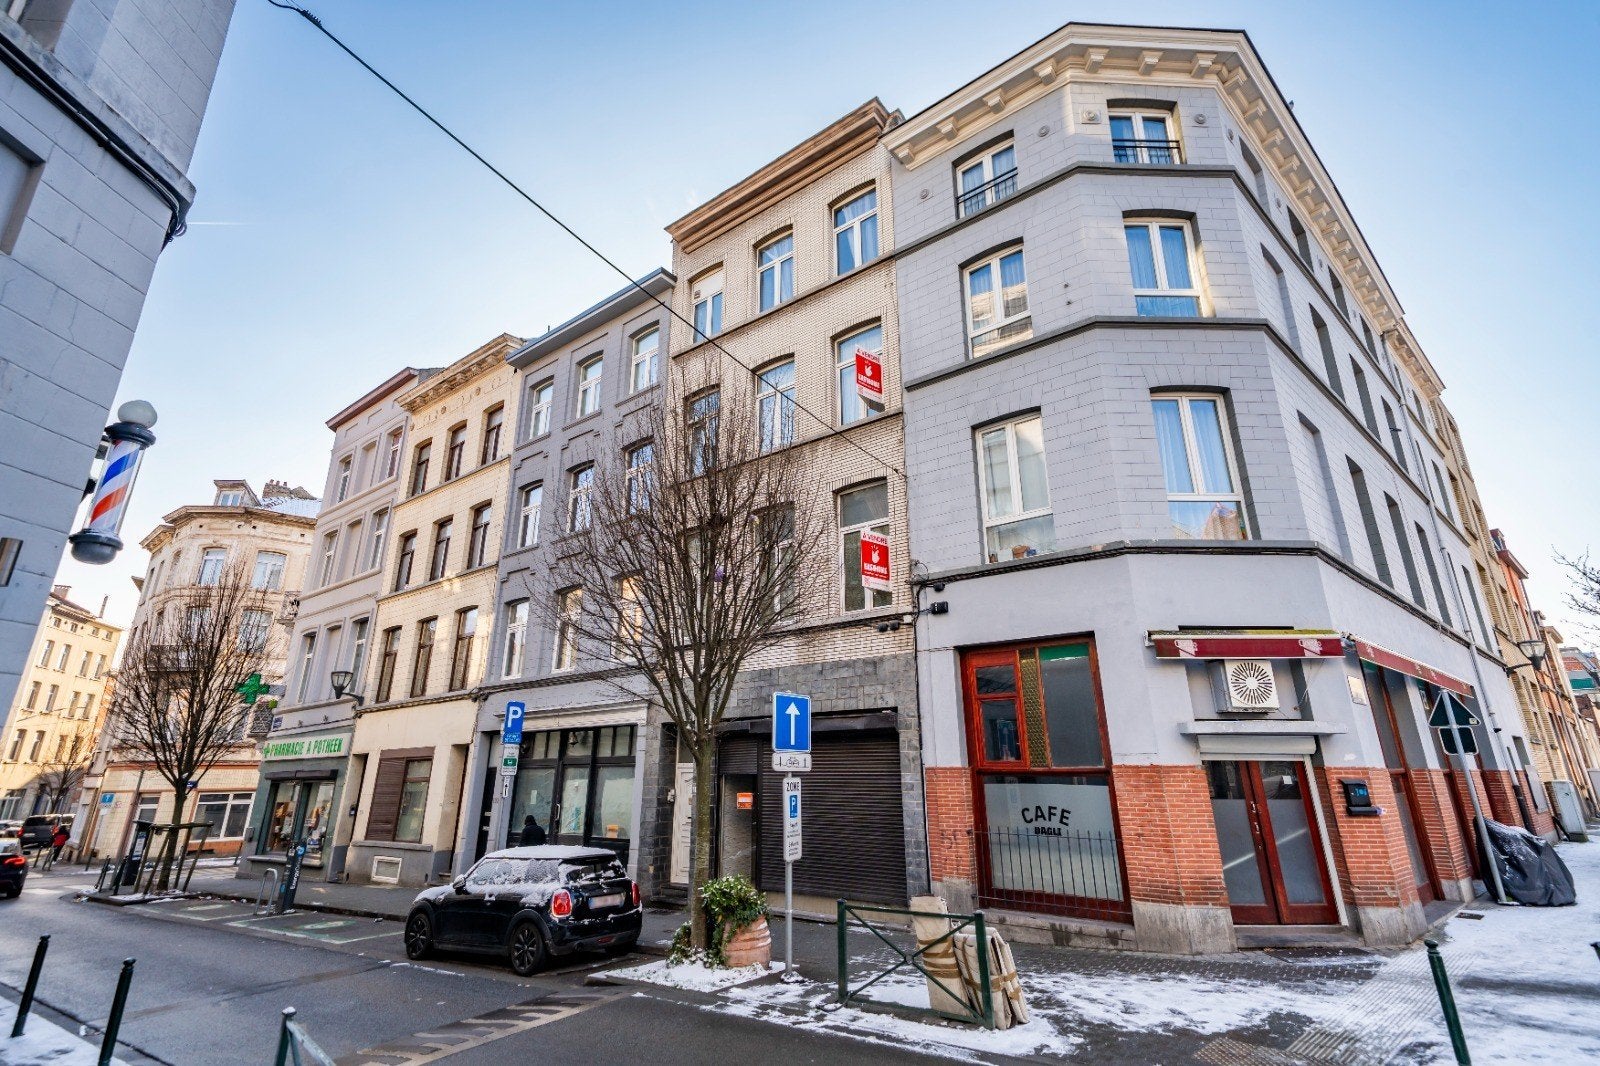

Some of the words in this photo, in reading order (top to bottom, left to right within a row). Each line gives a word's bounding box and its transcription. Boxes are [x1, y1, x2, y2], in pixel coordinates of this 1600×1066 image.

[507, 706, 522, 728] P
[270, 741, 305, 756] PHARMACIE
[786, 782, 800, 792] ZONE
[1021, 805, 1072, 826] CAFE
